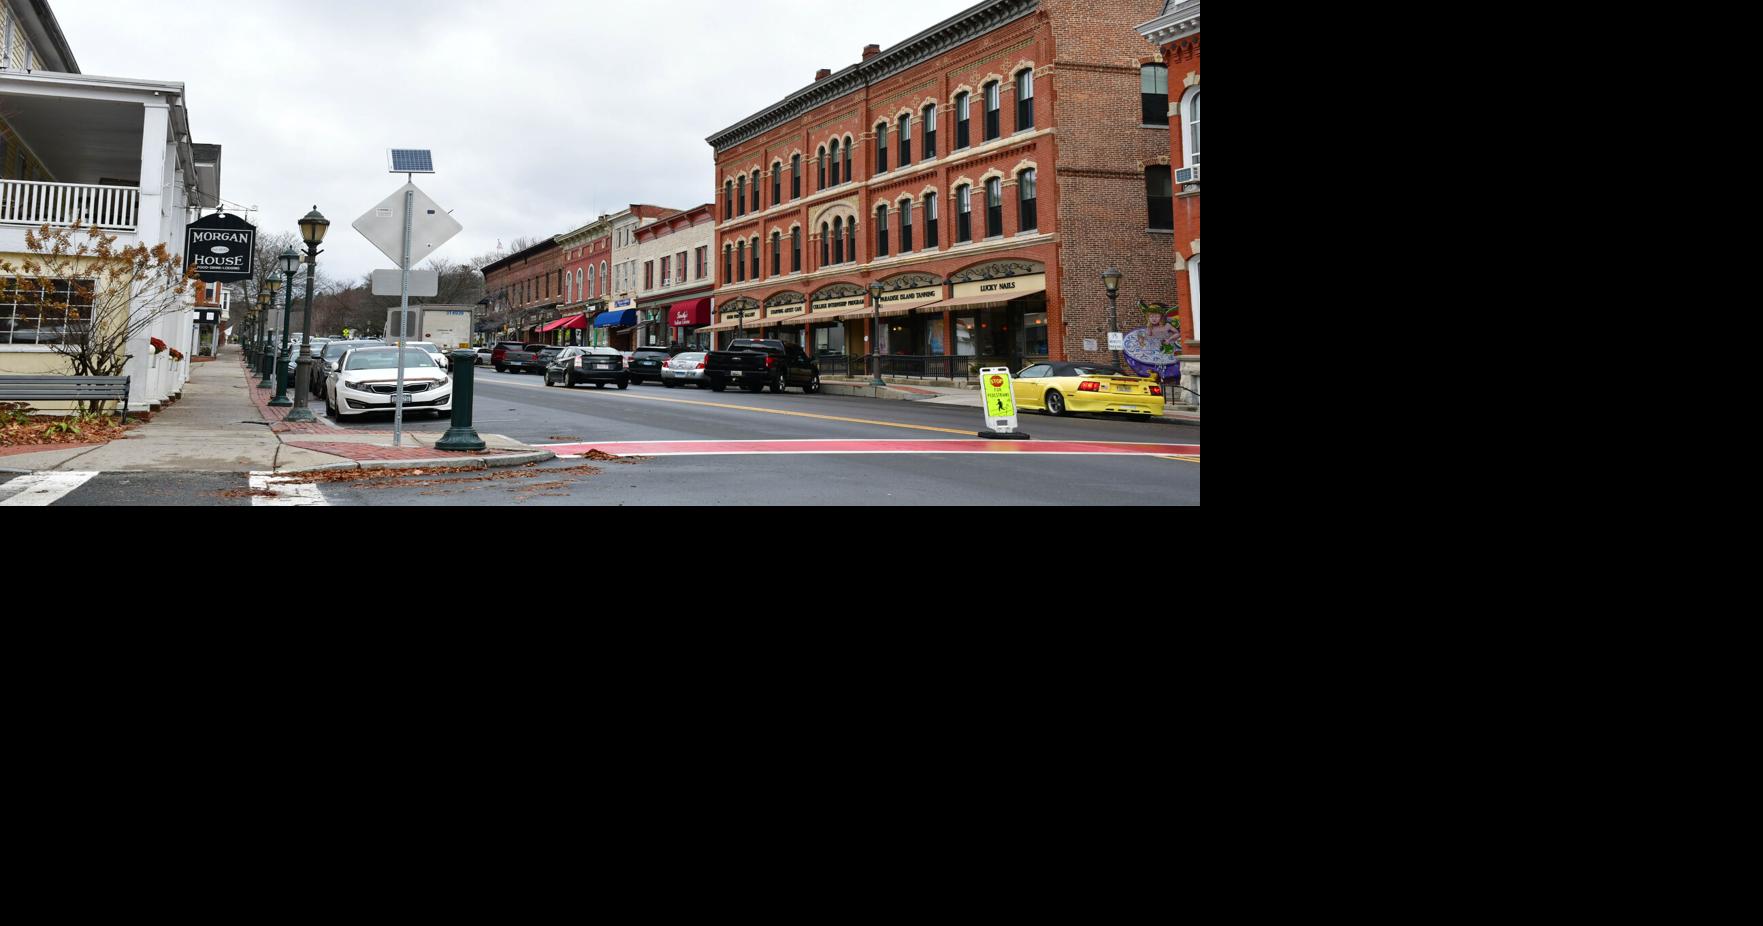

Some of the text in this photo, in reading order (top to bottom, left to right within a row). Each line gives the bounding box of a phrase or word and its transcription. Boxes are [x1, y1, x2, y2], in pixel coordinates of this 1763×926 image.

[193, 231, 248, 243] MORGAN
[194, 254, 243, 266] HOUSE
[980, 282, 1015, 292] LUCKY NAILS
[900, 292, 915, 300] ISLAND
[916, 290, 935, 299] TANNING
